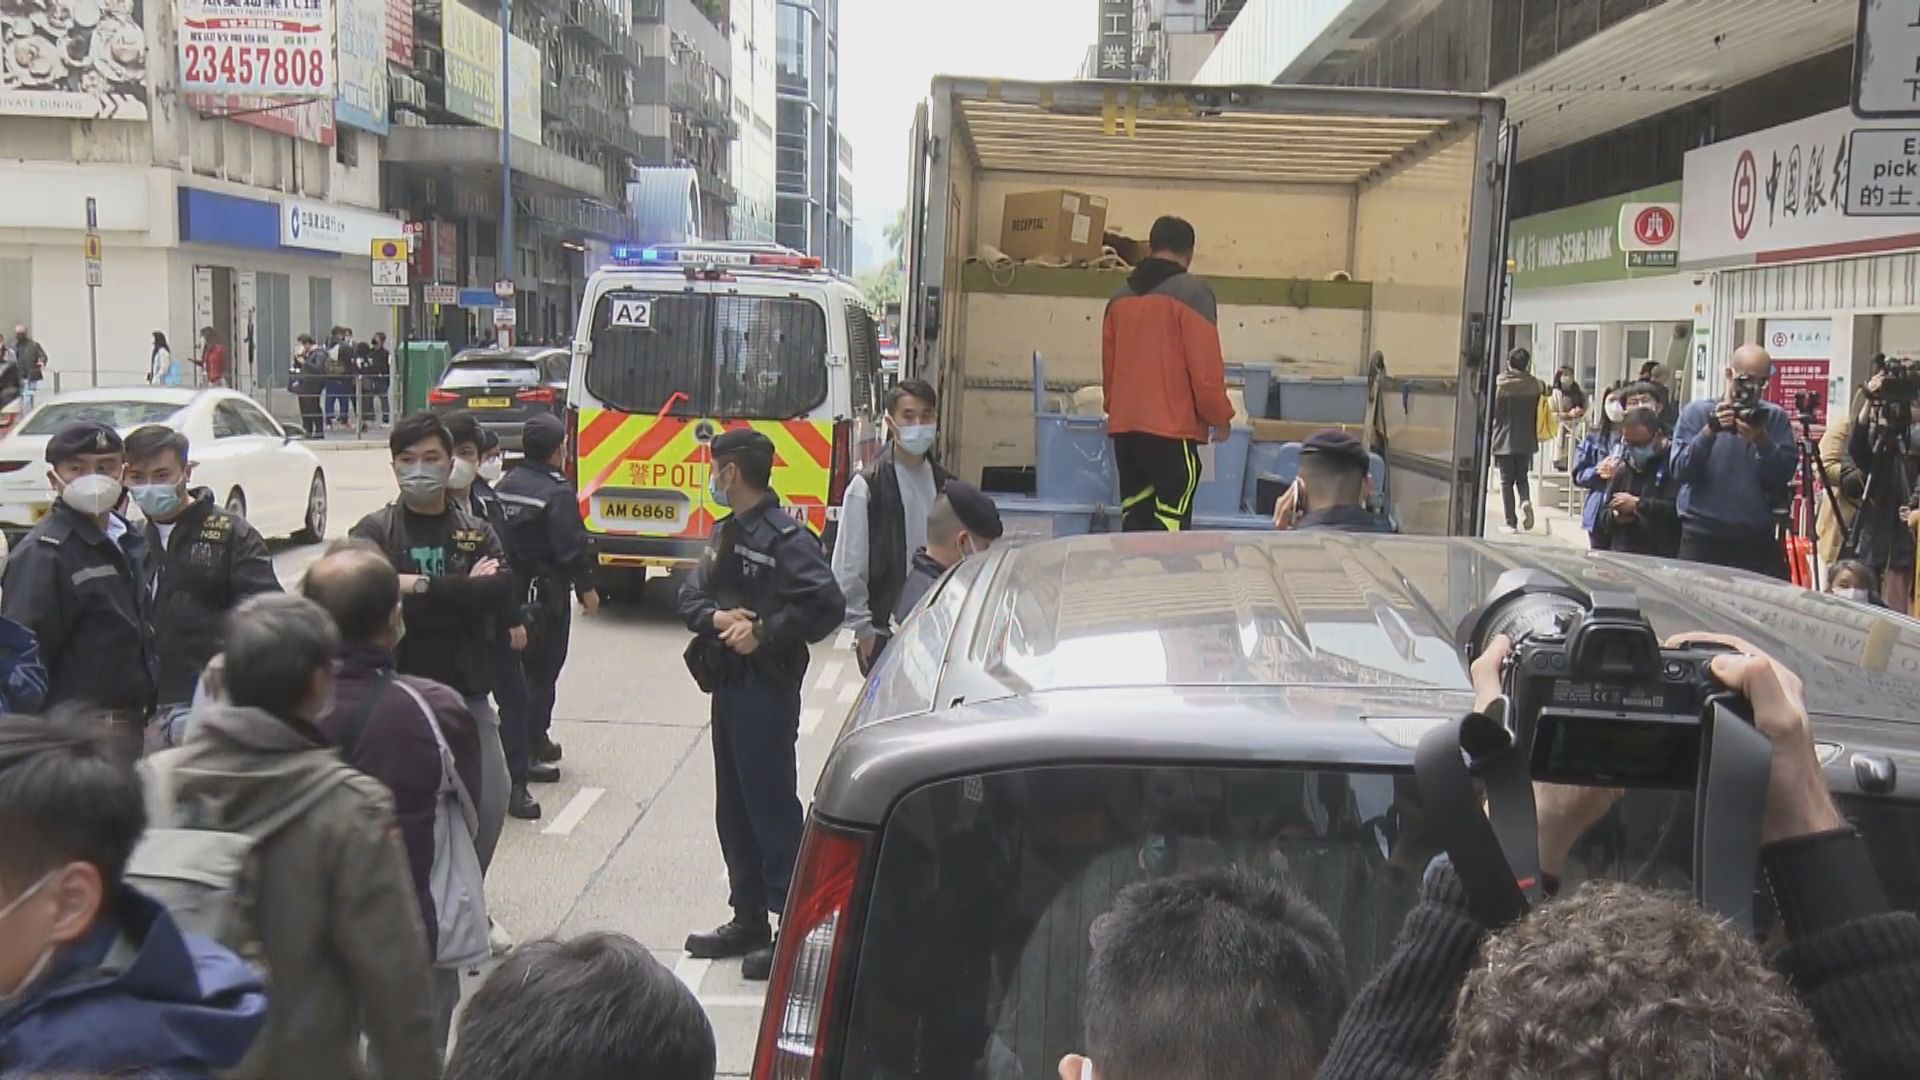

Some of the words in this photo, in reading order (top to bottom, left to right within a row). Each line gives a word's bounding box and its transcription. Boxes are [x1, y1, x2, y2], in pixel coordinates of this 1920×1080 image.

[1103, 0, 1128, 70] 工業
[185, 44, 324, 87] 23457808
[40, 99, 82, 110] DINING
[1859, 184, 1920, 206] 的士
[1538, 235, 1561, 267] HANG
[1562, 232, 1585, 265] SENG
[1586, 225, 1613, 262] BANK
[696, 253, 731, 264] POLICE
[616, 304, 646, 323] A2
[652, 463, 702, 488] POL
[606, 503, 627, 517] AM
[631, 503, 675, 519] 6868
